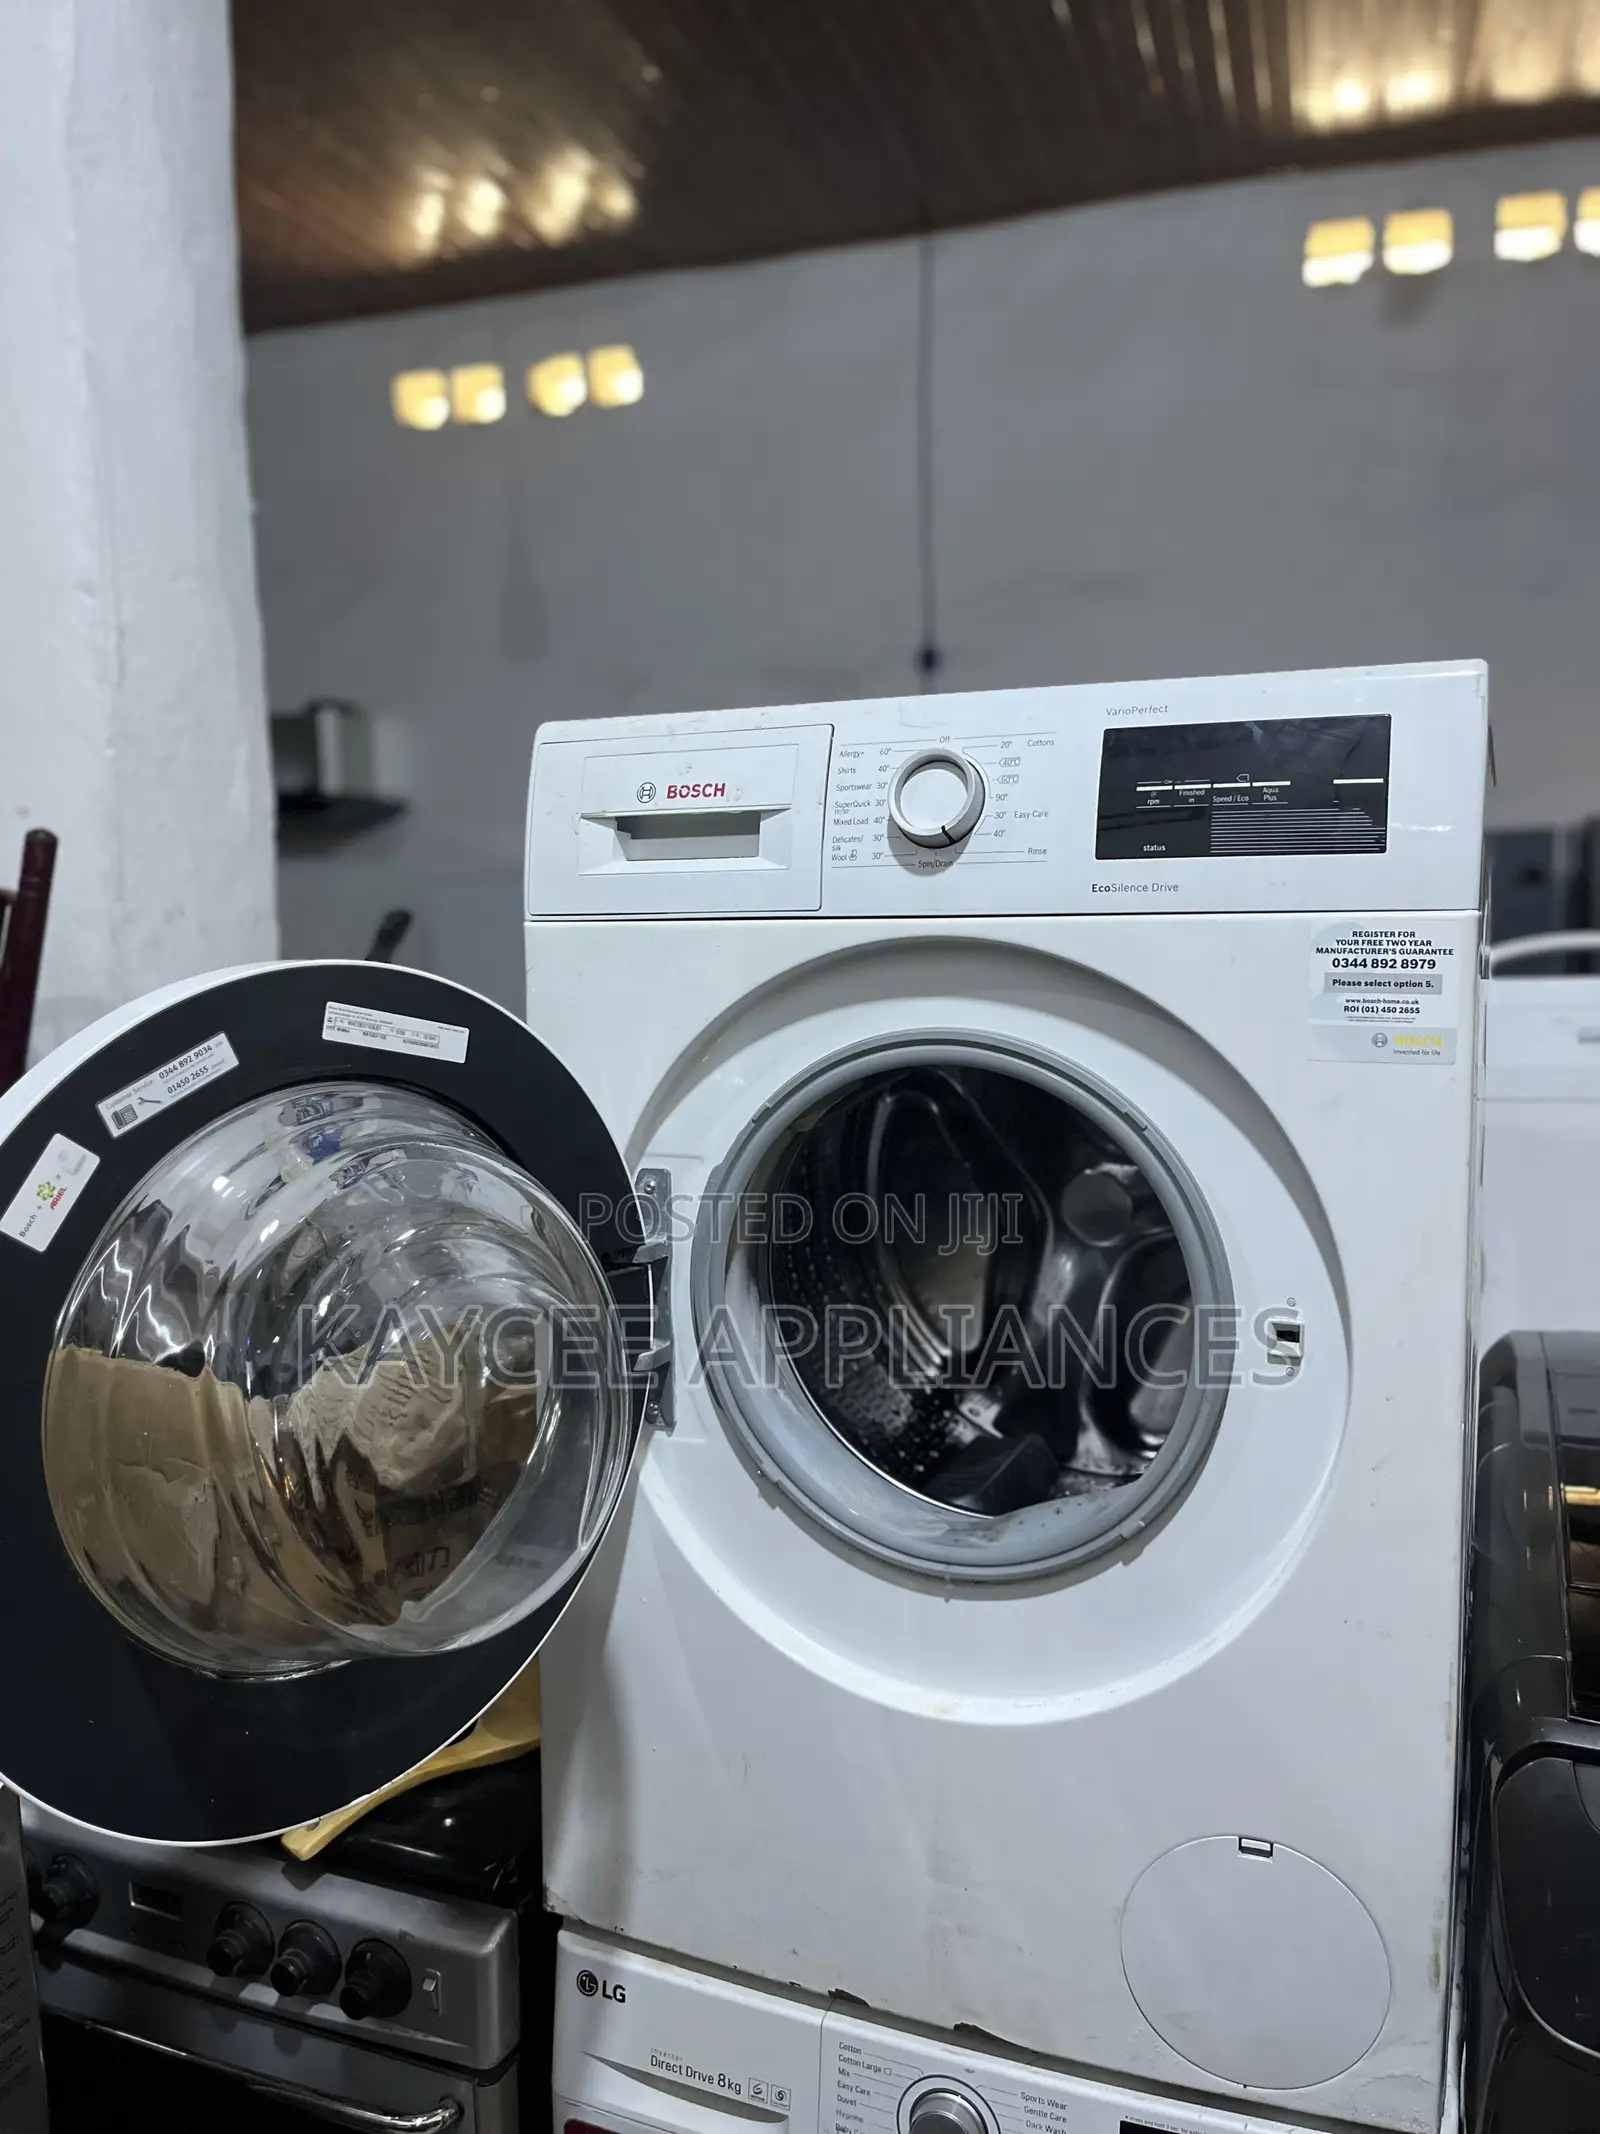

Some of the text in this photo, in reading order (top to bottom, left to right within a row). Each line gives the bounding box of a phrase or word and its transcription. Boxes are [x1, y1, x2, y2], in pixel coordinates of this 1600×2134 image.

[1106, 704, 1168, 716] VarioPerfect
[939, 735, 950, 743] Off
[1027, 739, 1055, 747] Cottons
[839, 750, 864, 758] Allergy+
[666, 783, 726, 799] BOSCH
[836, 783, 872, 792] Sportswear
[834, 800, 871, 809] SuperQuick
[833, 818, 852, 826] Mixed
[853, 816, 869, 825] Load
[832, 834, 863, 844] Delicates/
[1027, 847, 1047, 855] Rinse
[1143, 844, 1166, 852] status
[831, 853, 847, 861] Wool
[917, 860, 954, 868] Spin/Drain
[1091, 882, 1179, 893] EcoSilence Drive
[1316, 947, 1454, 956] MANUFACTURER'S GUARANTEE
[1332, 958, 1436, 969] 0344 892 8979
[1332, 979, 1362, 987] Please
[1364, 979, 1392, 988] select
[1394, 980, 1423, 989] option
[1361, 1006, 1379, 1014] (01)
[1399, 1006, 1421, 1014] 2655
[158, 1064, 178, 1080] 0344
[178, 1056, 193, 1068] 892
[193, 1044, 213, 1059] 9034
[167, 1065, 209, 1094] 01450 2655
[50, 1186, 67, 1210] ARIEL
[19, 1214, 37, 1237] Bosch
[601, 1980, 626, 2003] LG
[838, 2042, 862, 2055] Cotton
[838, 2054, 882, 2073] Cotton Large
[650, 2055, 683, 2075] Direct
[685, 2065, 715, 2085] Drive
[838, 2067, 850, 2077] Mix
[837, 2080, 871, 2096] Easy Care
[836, 2094, 857, 2106] Duvet
[1020, 2091, 1068, 2110] Sports Wear
[1024, 2105, 1067, 2123] Gentle Care
[1026, 2120, 1067, 2134] Dark Wash
